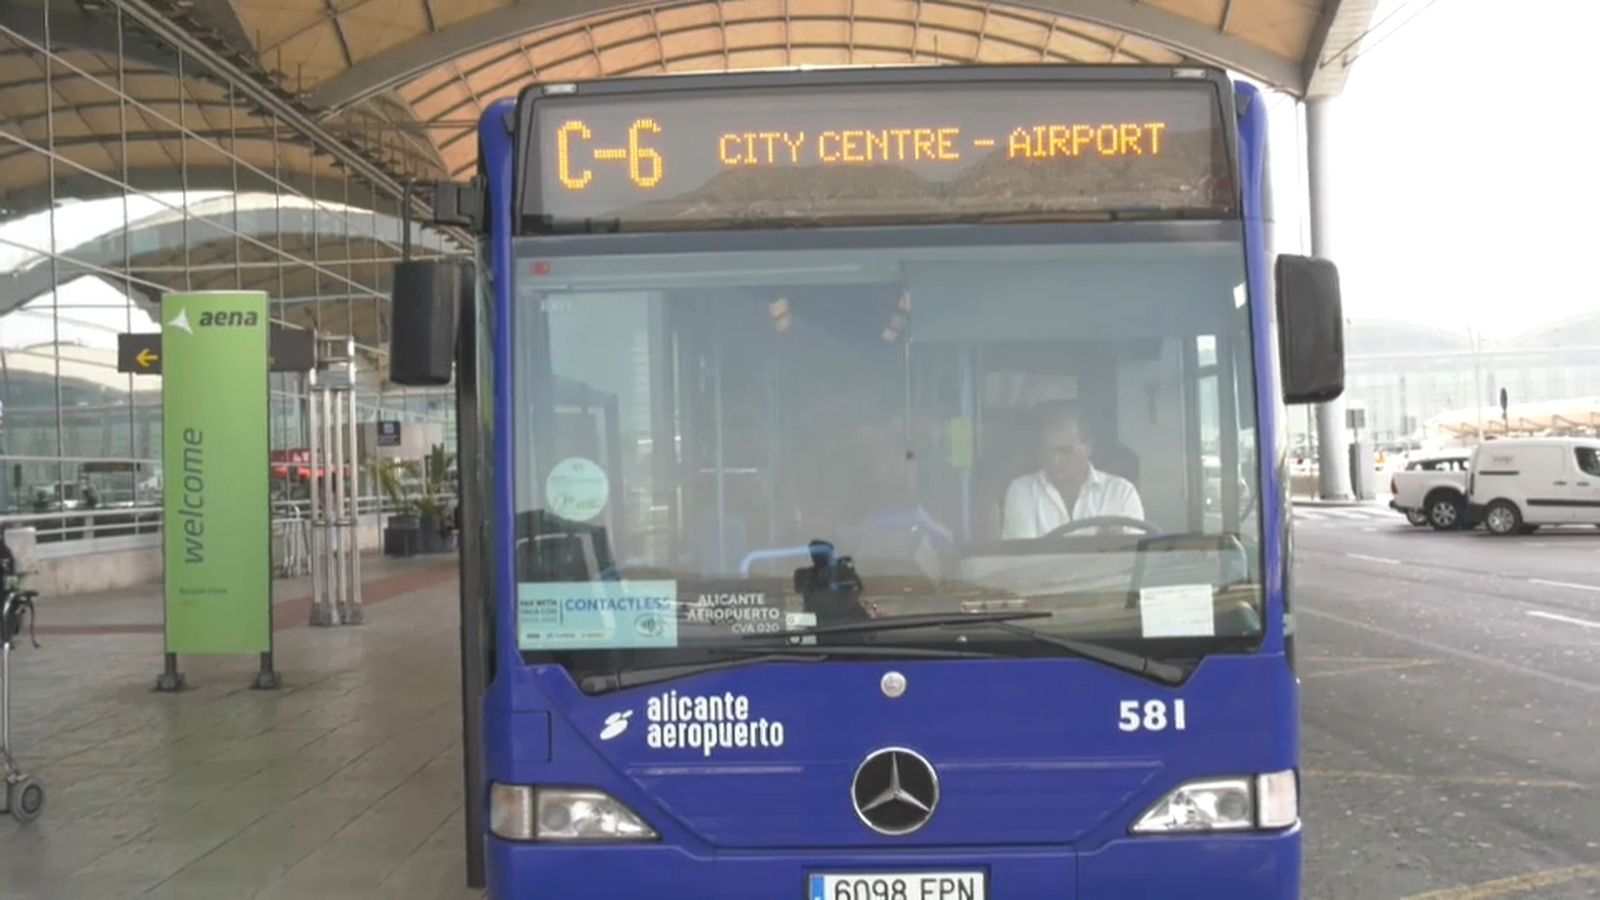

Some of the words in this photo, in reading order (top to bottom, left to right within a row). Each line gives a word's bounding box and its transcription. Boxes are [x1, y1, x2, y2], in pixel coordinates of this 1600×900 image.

[556, 118, 664, 190] C-6
[719, 131, 806, 164] CITY
[818, 129, 961, 163] CENTRE
[1008, 122, 1166, 158] AIRPORT
[199, 308, 259, 327] aena
[179, 427, 205, 565] welcome
[564, 597, 671, 613] CONTACTLESS
[687, 607, 780, 621] AEROPUERTO
[698, 593, 765, 606] ALICANTE
[647, 690, 749, 721] alicante
[1118, 698, 1186, 733] 581
[647, 718, 784, 757] aeropuerto
[834, 879, 908, 900] 6098
